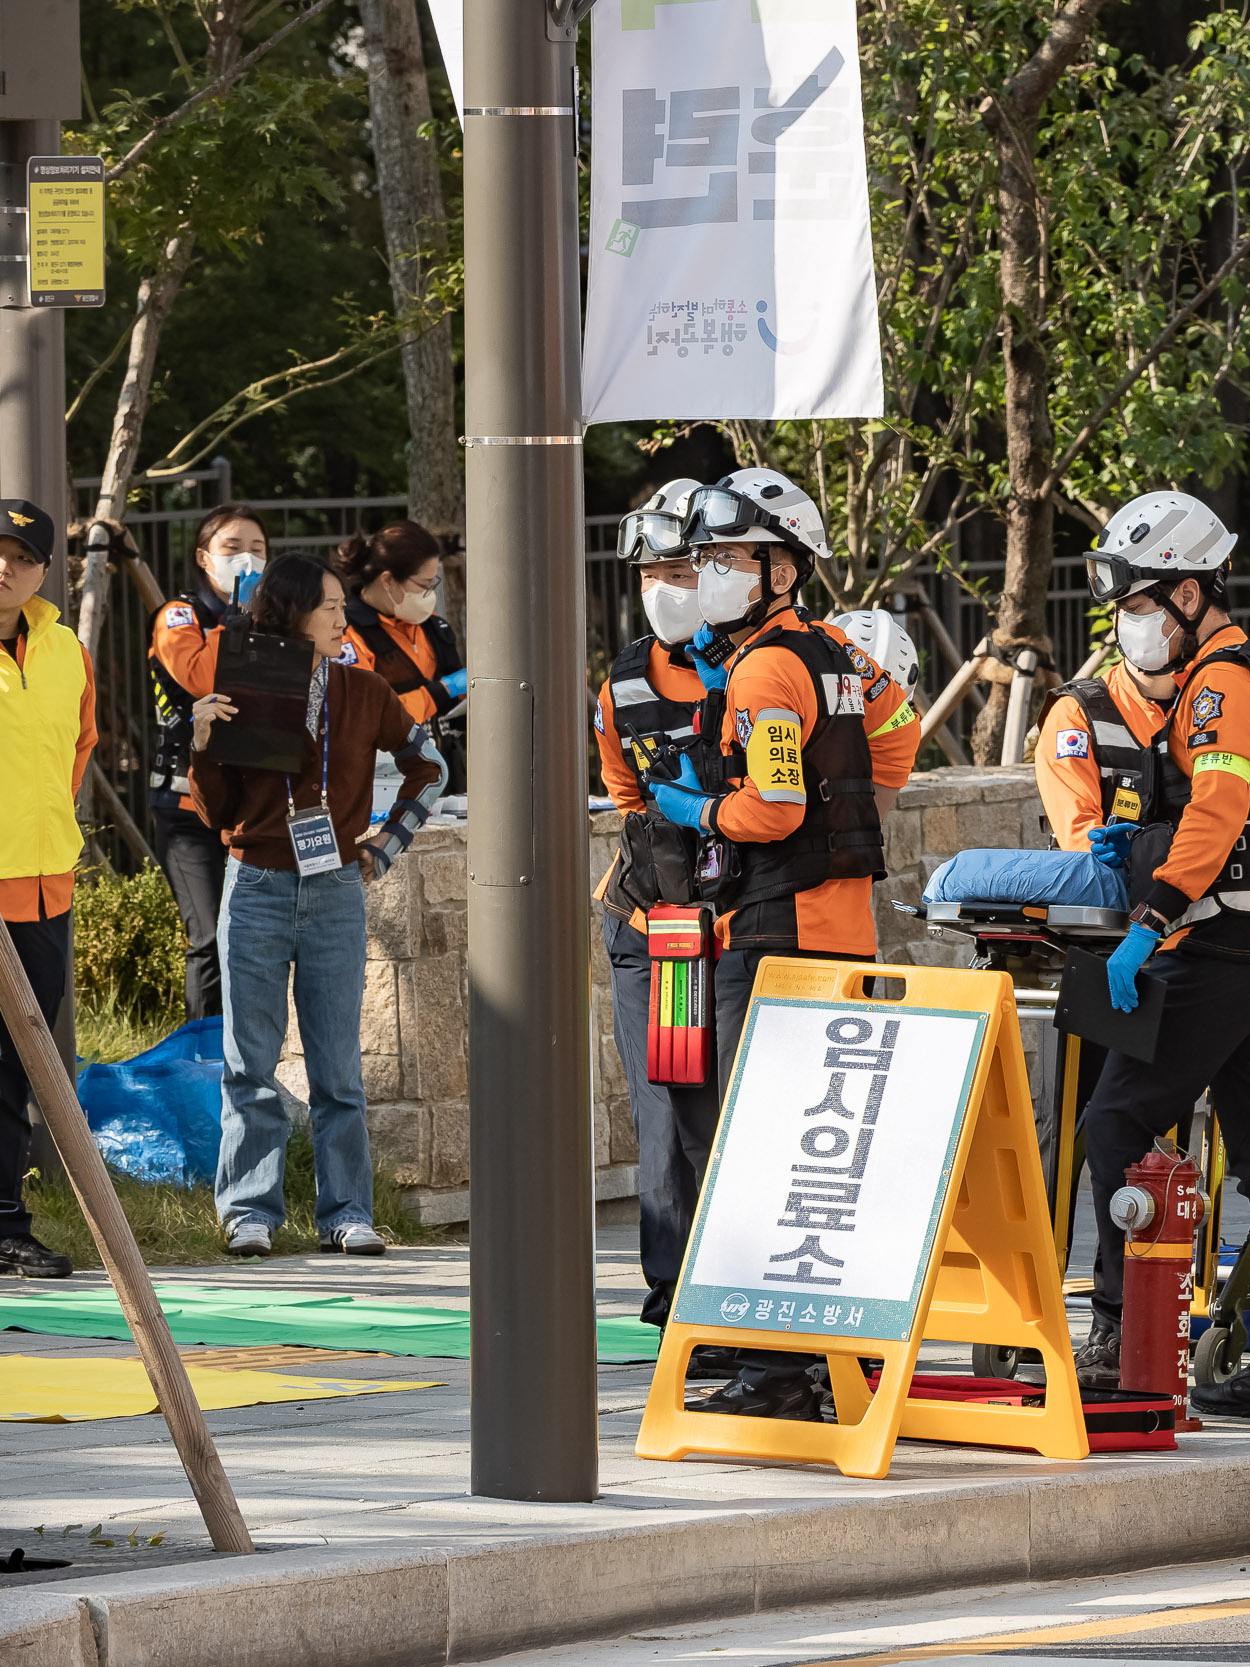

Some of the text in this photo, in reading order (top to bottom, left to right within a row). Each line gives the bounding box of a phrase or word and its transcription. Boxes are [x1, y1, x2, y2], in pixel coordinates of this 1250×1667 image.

[767, 725, 797, 745] 임시
[769, 746, 799, 765] 의료
[1200, 752, 1233, 766] 분류반
[770, 768, 800, 786] 소장
[1121, 776, 1135, 788] 광
[296, 833, 332, 851] 평가요원
[762, 1016, 901, 1287] 임시의료소
[755, 1299, 864, 1328] 광진소방서
